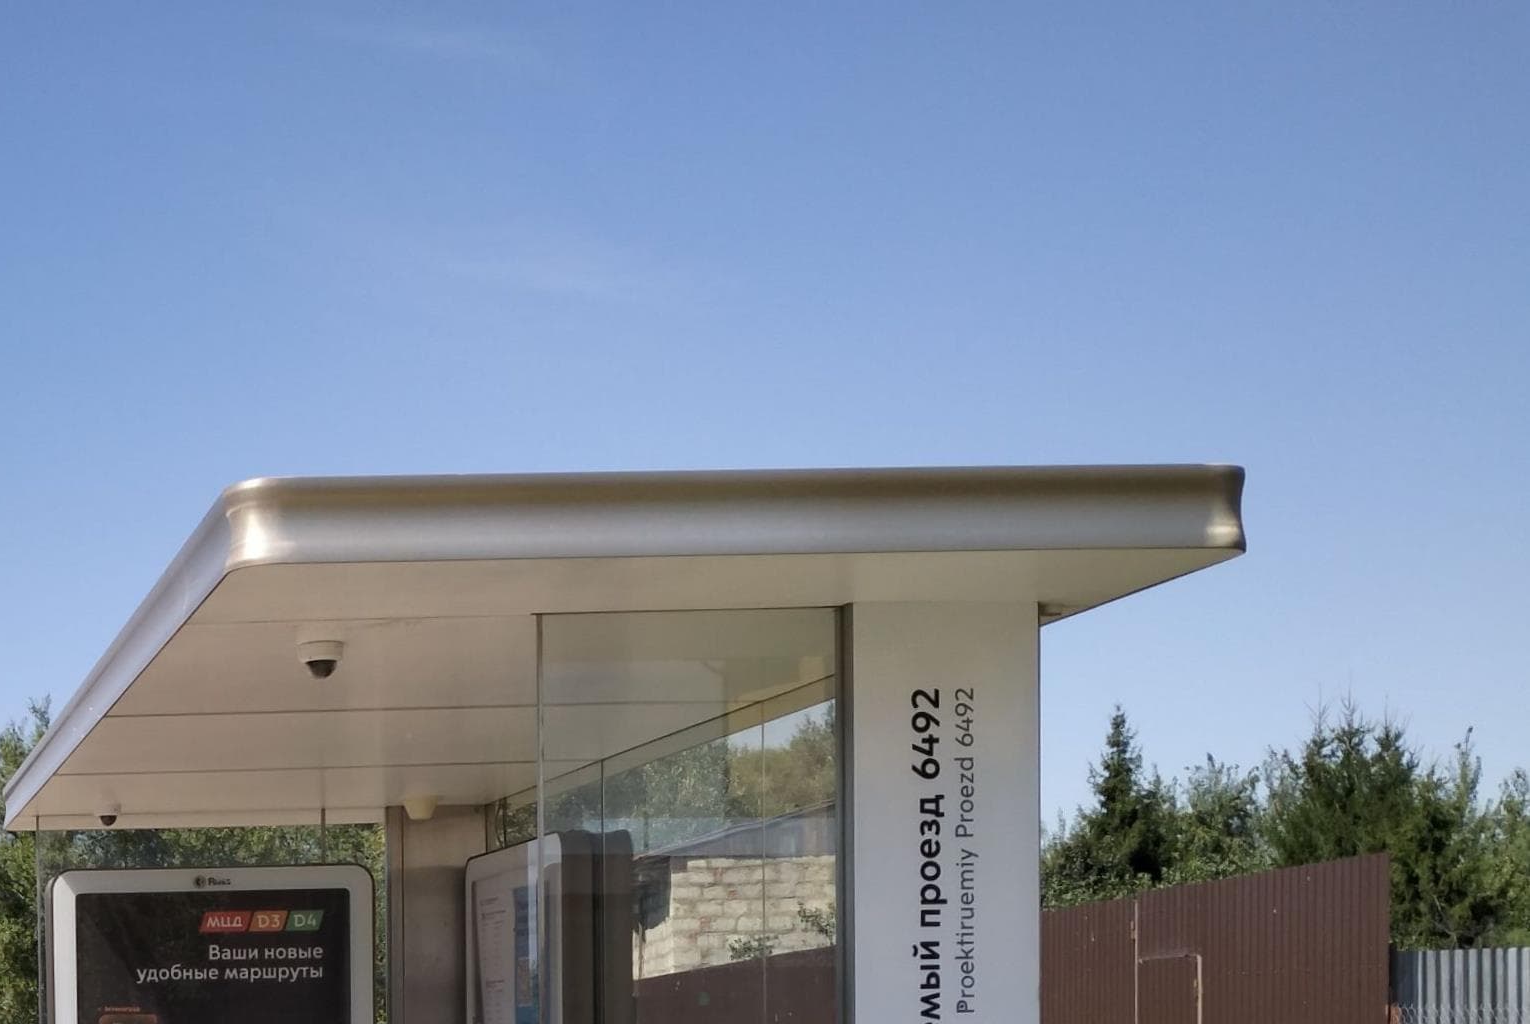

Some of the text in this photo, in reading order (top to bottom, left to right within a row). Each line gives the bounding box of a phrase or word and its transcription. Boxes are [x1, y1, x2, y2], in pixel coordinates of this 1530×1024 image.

[911, 688, 940, 780] 6492
[920, 795, 948, 927] проезд
[954, 688, 979, 1013] Proektiruemiy Proezd 6492
[206, 914, 316, 928] МЦД D3 D4
[136, 964, 323, 984] удобные маршруты
[209, 945, 323, 960] Ваши новые
